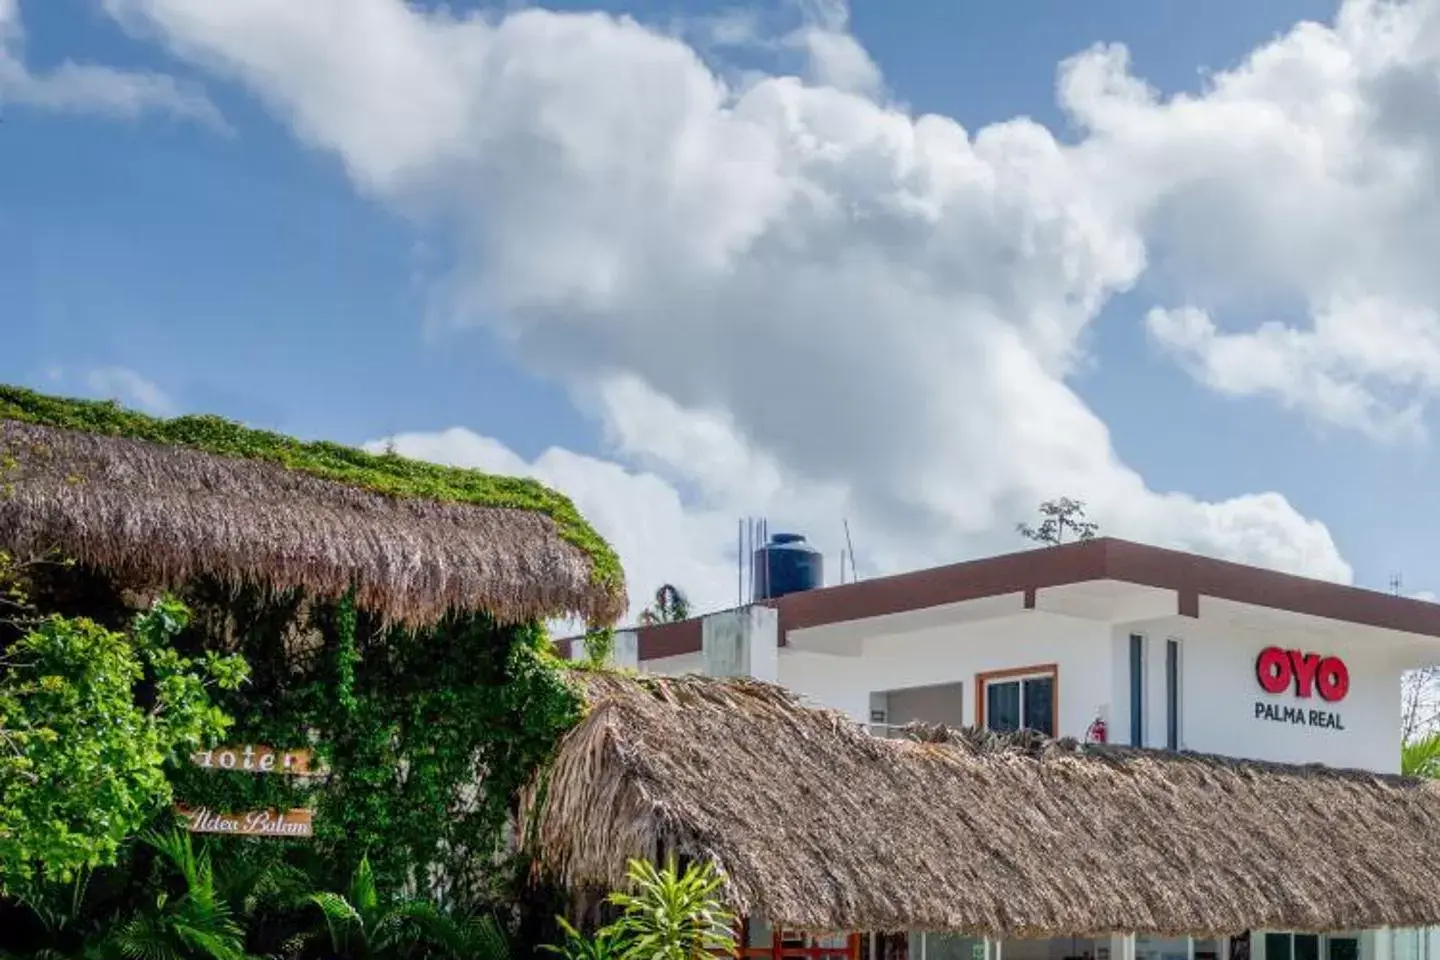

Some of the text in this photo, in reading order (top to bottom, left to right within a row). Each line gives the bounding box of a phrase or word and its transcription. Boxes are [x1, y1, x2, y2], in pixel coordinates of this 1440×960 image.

[1255, 645, 1349, 703] OYO
[1255, 701, 1345, 730] PALMA REAL
